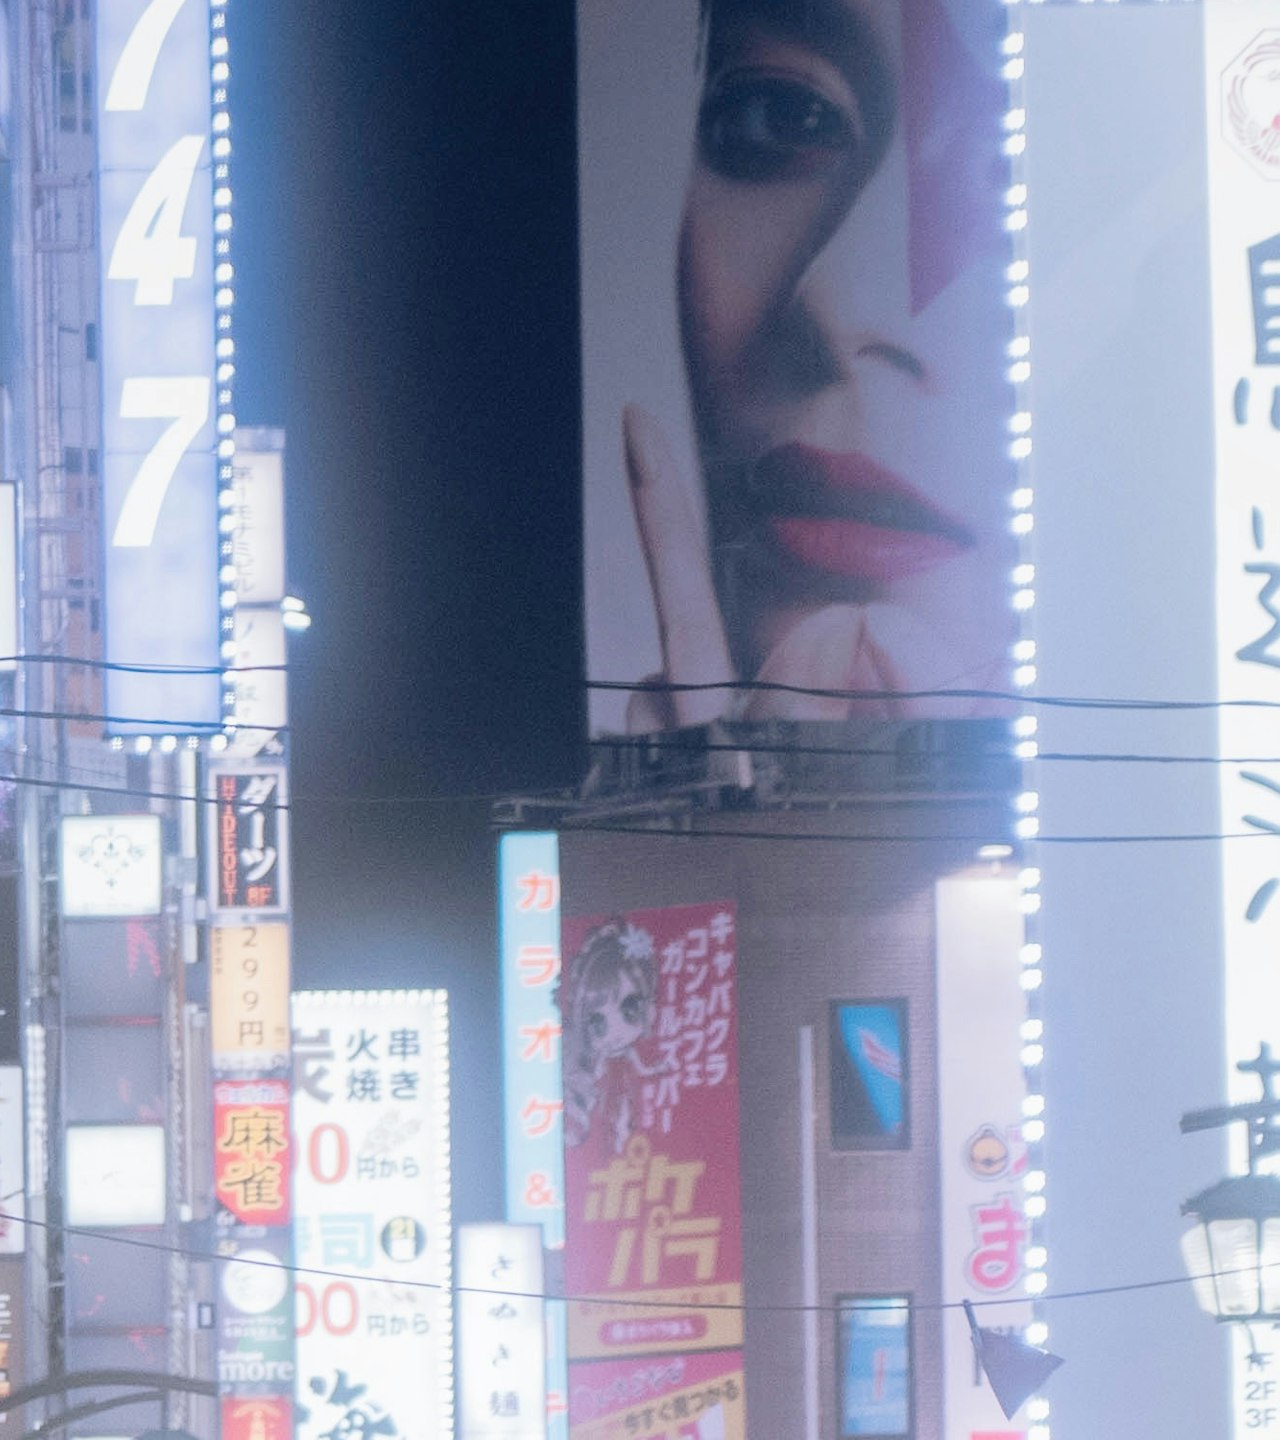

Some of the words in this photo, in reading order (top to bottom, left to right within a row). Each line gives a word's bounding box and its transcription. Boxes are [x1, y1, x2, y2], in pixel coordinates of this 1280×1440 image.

[240, 926, 264, 1046] 299円
[683, 928, 709, 1087] コンカフェ
[705, 912, 734, 1087] キャバクラ
[222, 1111, 285, 1208] 麻雀
[220, 1359, 293, 1382] more
[1244, 1381, 1277, 1401] 2F
[1244, 1408, 1277, 1429] 3F
